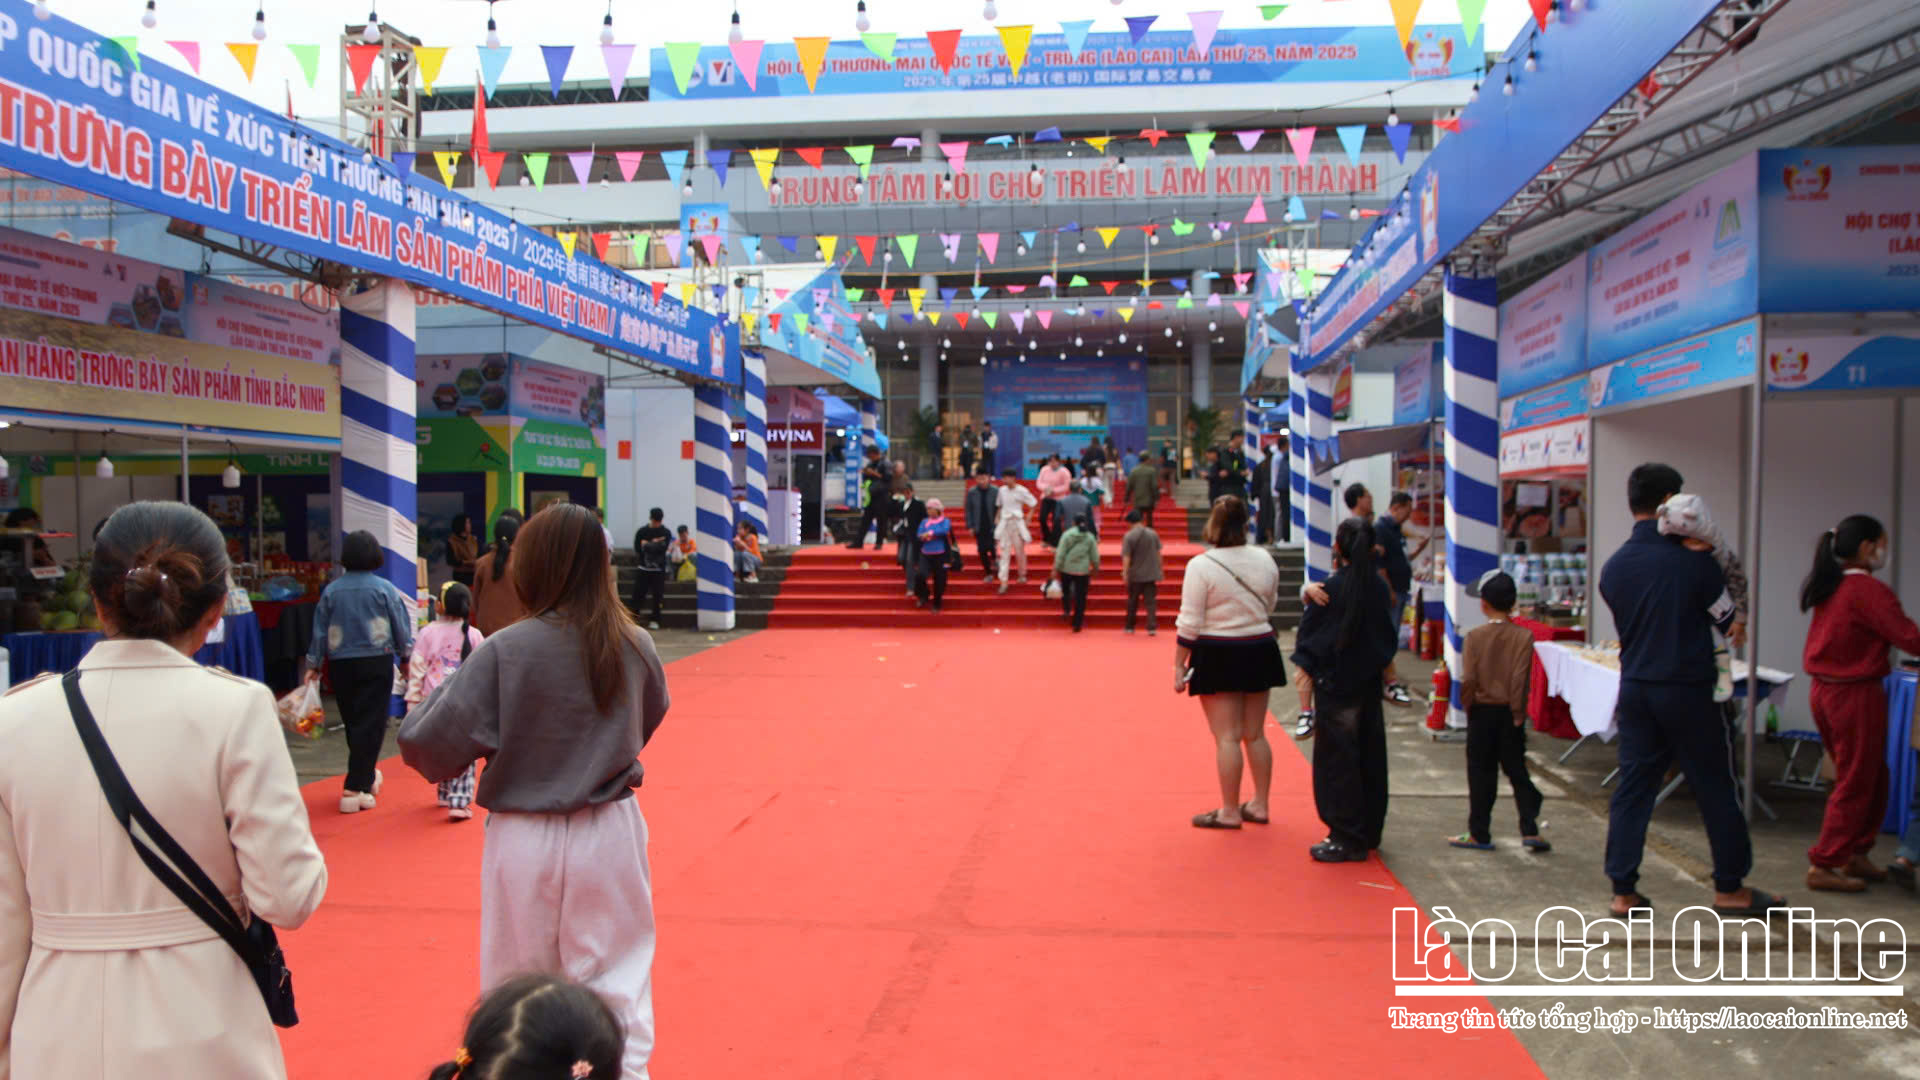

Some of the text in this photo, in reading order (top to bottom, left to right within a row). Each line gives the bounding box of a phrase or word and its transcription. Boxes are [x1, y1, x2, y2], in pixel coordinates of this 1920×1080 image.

[767, 59, 793, 77] HỘI
[895, 56, 926, 75] MẠI
[976, 50, 995, 68] TẾ
[1213, 43, 1245, 63] THỨ
[1247, 47, 1273, 63] 25,
[1275, 43, 1313, 61] NĂM
[1318, 44, 1358, 60] 2025
[28, 27, 122, 98] QUỐC
[131, 70, 181, 122] GIA
[186, 93, 220, 137] VỀ
[225, 108, 275, 157] XÚC
[477, 216, 510, 250] 2025
[0, 82, 153, 190] TRƯNG
[160, 138, 237, 213] BÀY
[241, 166, 331, 243] TRIỂN
[336, 199, 392, 261] LÃM
[395, 219, 443, 278] SẢN
[446, 241, 504, 299] PHẨM
[505, 264, 545, 313] PHÍA
[546, 280, 577, 328] VIỆT
[868, 167, 926, 203] TÂM
[1053, 157, 1136, 198] TRIỂN
[1144, 160, 1208, 196] LÃM
[1216, 166, 1272, 193] KIM
[1280, 157, 1377, 193] THÀNH
[1845, 210, 1872, 232] HỘI
[24, 336, 76, 384] HÀNG
[80, 350, 134, 390] TRƯNG
[138, 356, 169, 393] BÀY
[171, 357, 201, 398] SẢN
[203, 361, 242, 404] PHẨM
[244, 368, 272, 406] TỈNH
[273, 373, 297, 410] BẮC
[299, 384, 326, 413] NINH
